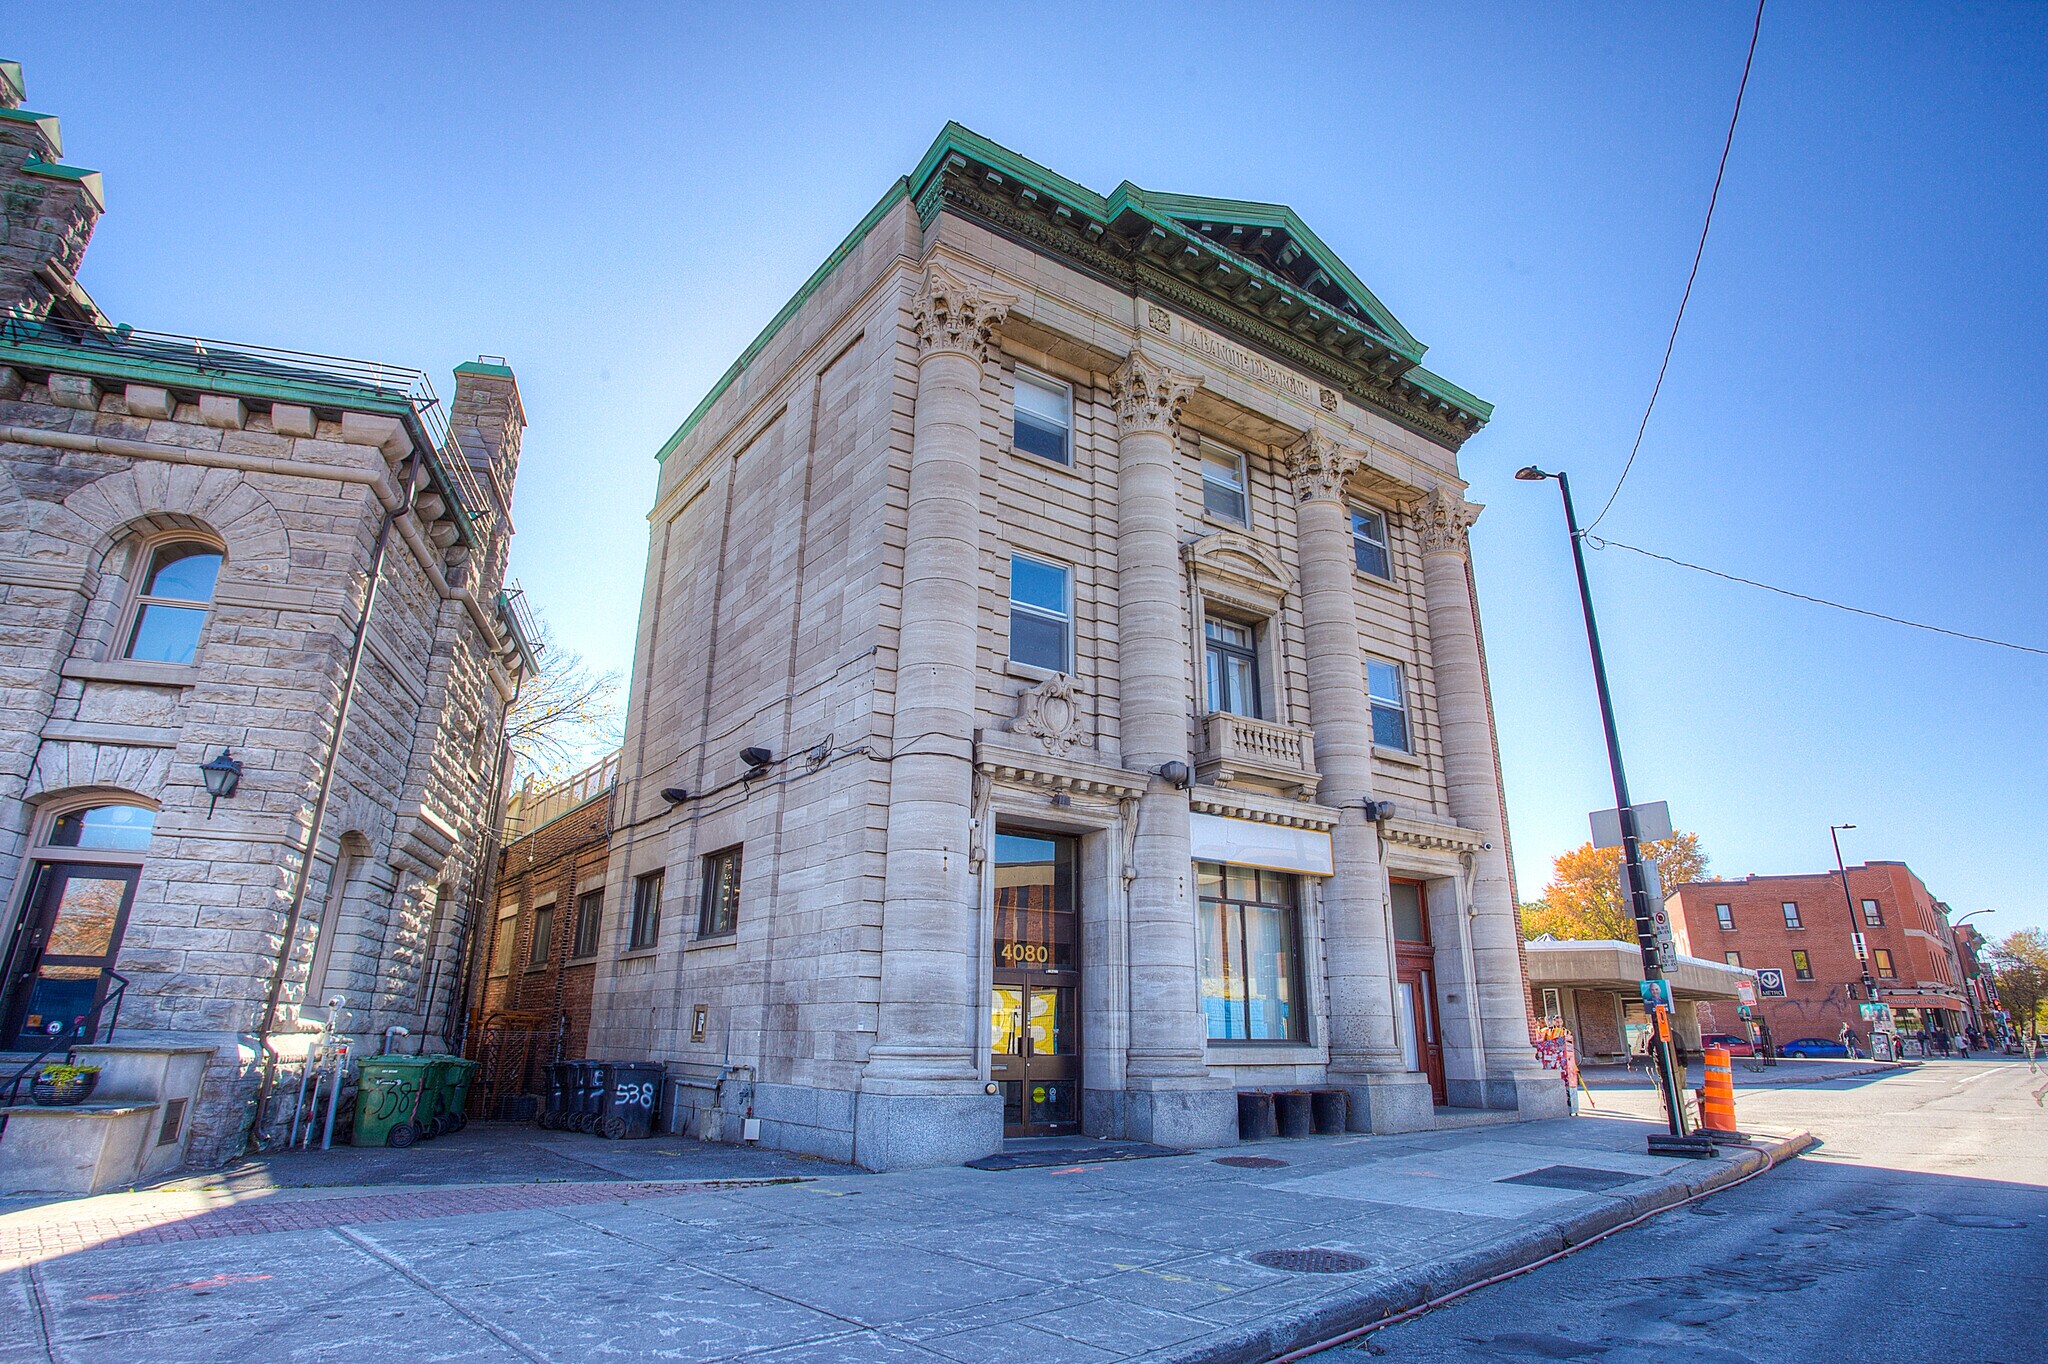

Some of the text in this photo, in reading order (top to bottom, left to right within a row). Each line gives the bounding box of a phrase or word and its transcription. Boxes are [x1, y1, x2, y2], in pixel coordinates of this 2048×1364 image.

[1200, 331, 1249, 371] BANQUE
[1002, 944, 1048, 963] 4080
[1662, 943, 1669, 954] P
[614, 1081, 654, 1108] 538
